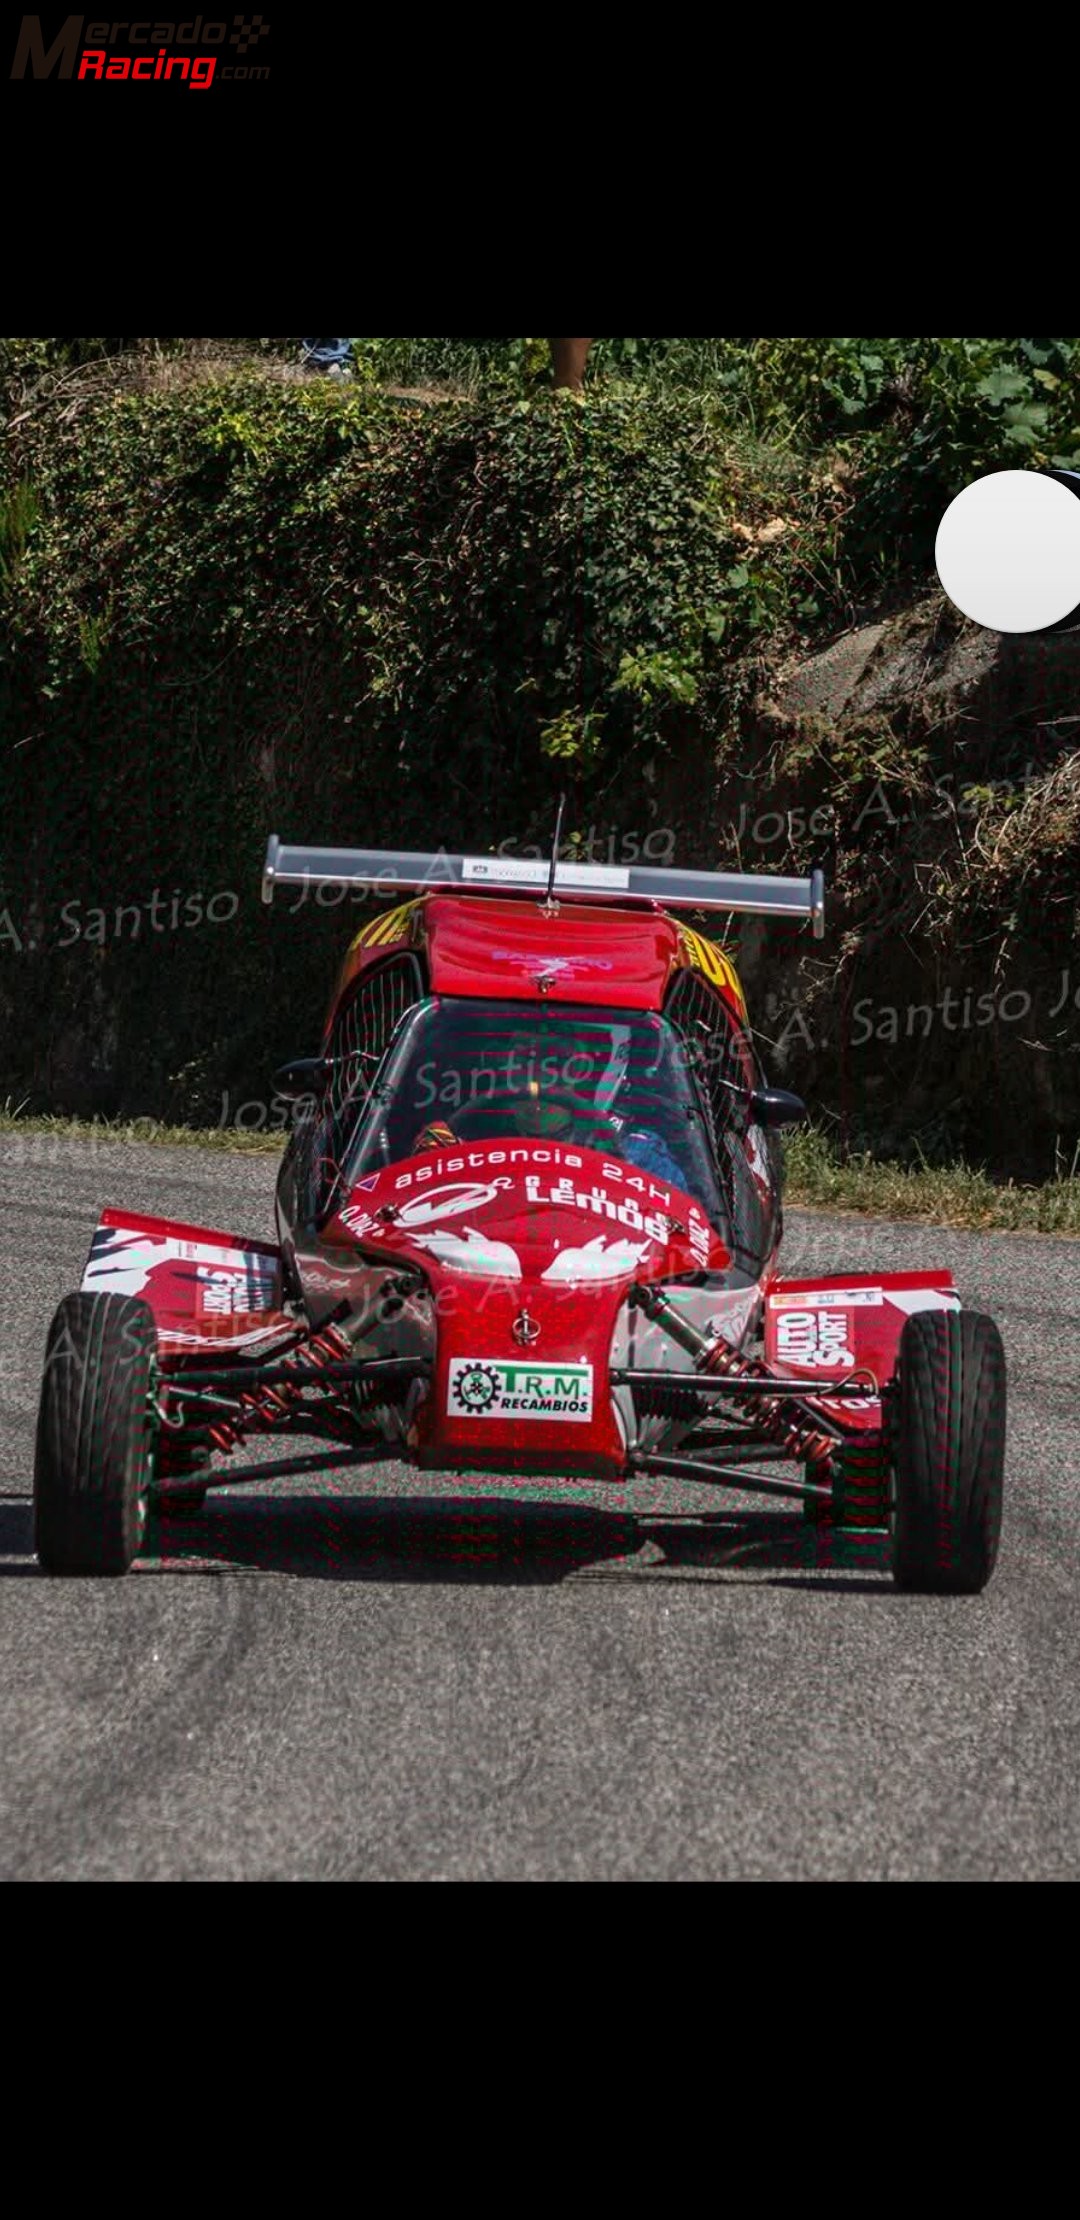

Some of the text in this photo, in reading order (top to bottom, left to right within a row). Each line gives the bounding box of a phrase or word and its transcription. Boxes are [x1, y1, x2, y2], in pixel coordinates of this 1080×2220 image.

[395, 1149, 583, 1190] asistencia
[602, 1162, 671, 1207] 24H
[196, 1266, 238, 1316] SPORT
[776, 1311, 817, 1368] AUTO
[814, 1310, 855, 1367] SPORT
[492, 1364, 589, 1400] T.R.M.
[500, 1397, 589, 1412] RECAMBIOS
